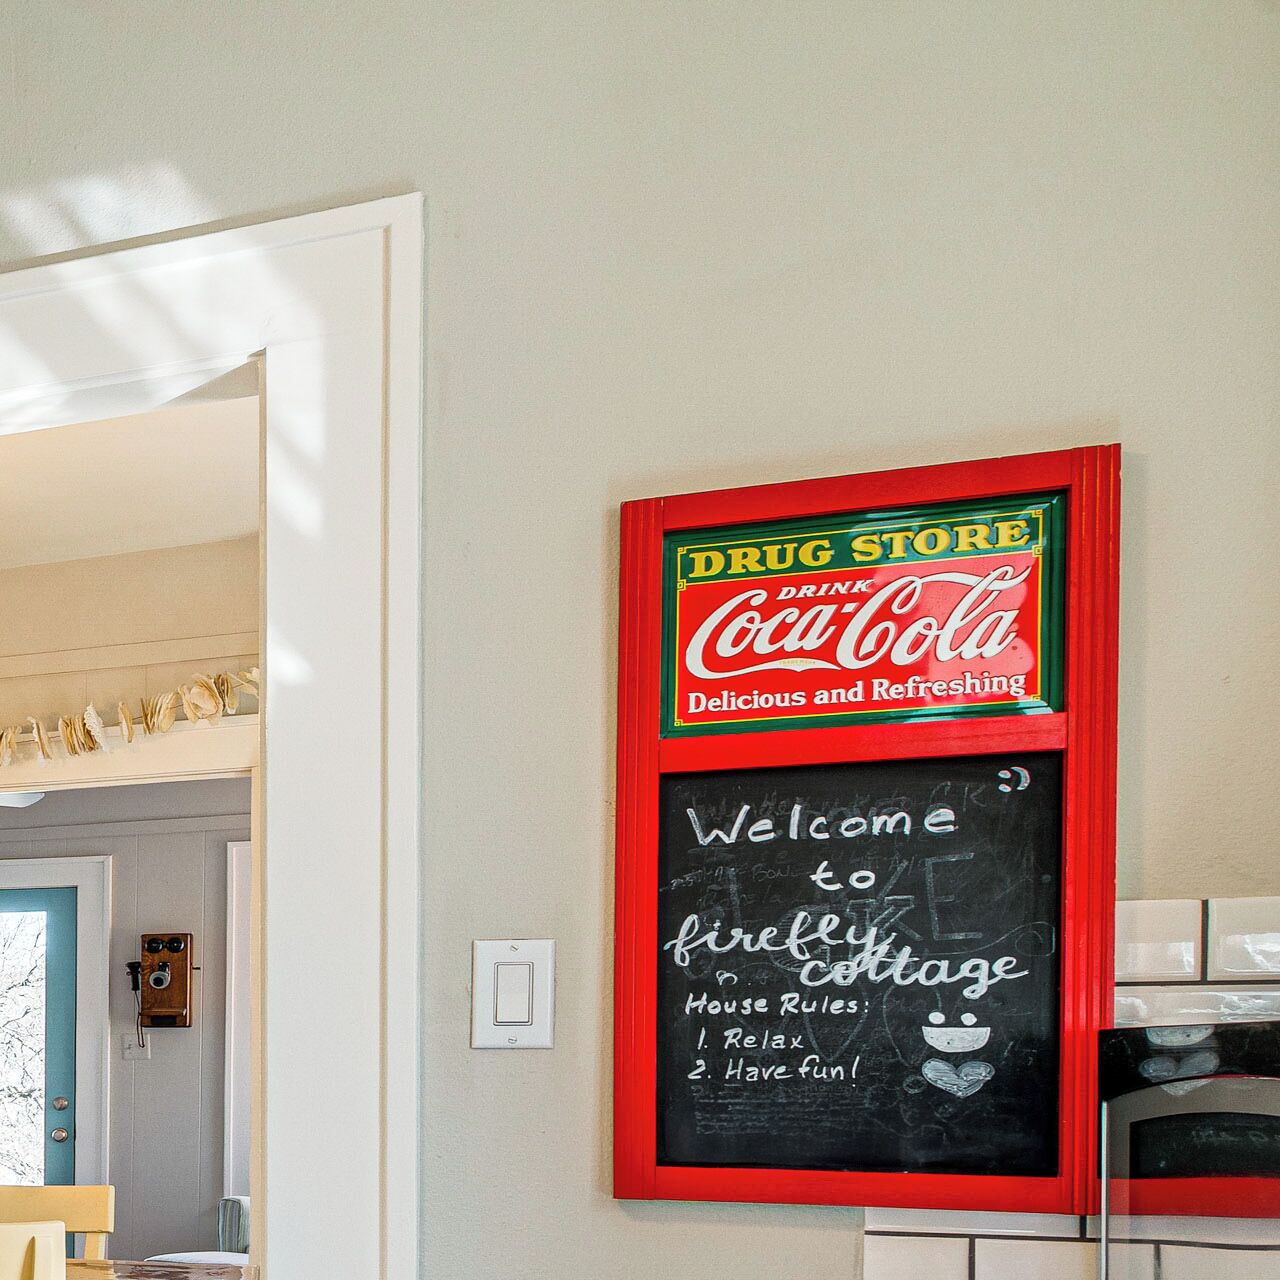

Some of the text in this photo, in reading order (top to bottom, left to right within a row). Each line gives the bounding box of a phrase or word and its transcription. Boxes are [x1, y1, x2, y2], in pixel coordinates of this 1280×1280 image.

[688, 519, 1031, 578] DRUG STORE
[776, 579, 876, 601] DRINK
[685, 564, 1032, 680] Coca-Cola
[688, 671, 1027, 714] Delicious and Refreshing
[686, 804, 960, 846] Welcome
[810, 860, 876, 891] to
[663, 911, 898, 976] firefly
[799, 945, 1029, 1000] cottage
[685, 992, 870, 1016] House Rules:
[697, 1027, 805, 1050] 1. Relax
[687, 1054, 861, 1087] 2. Have fun!
